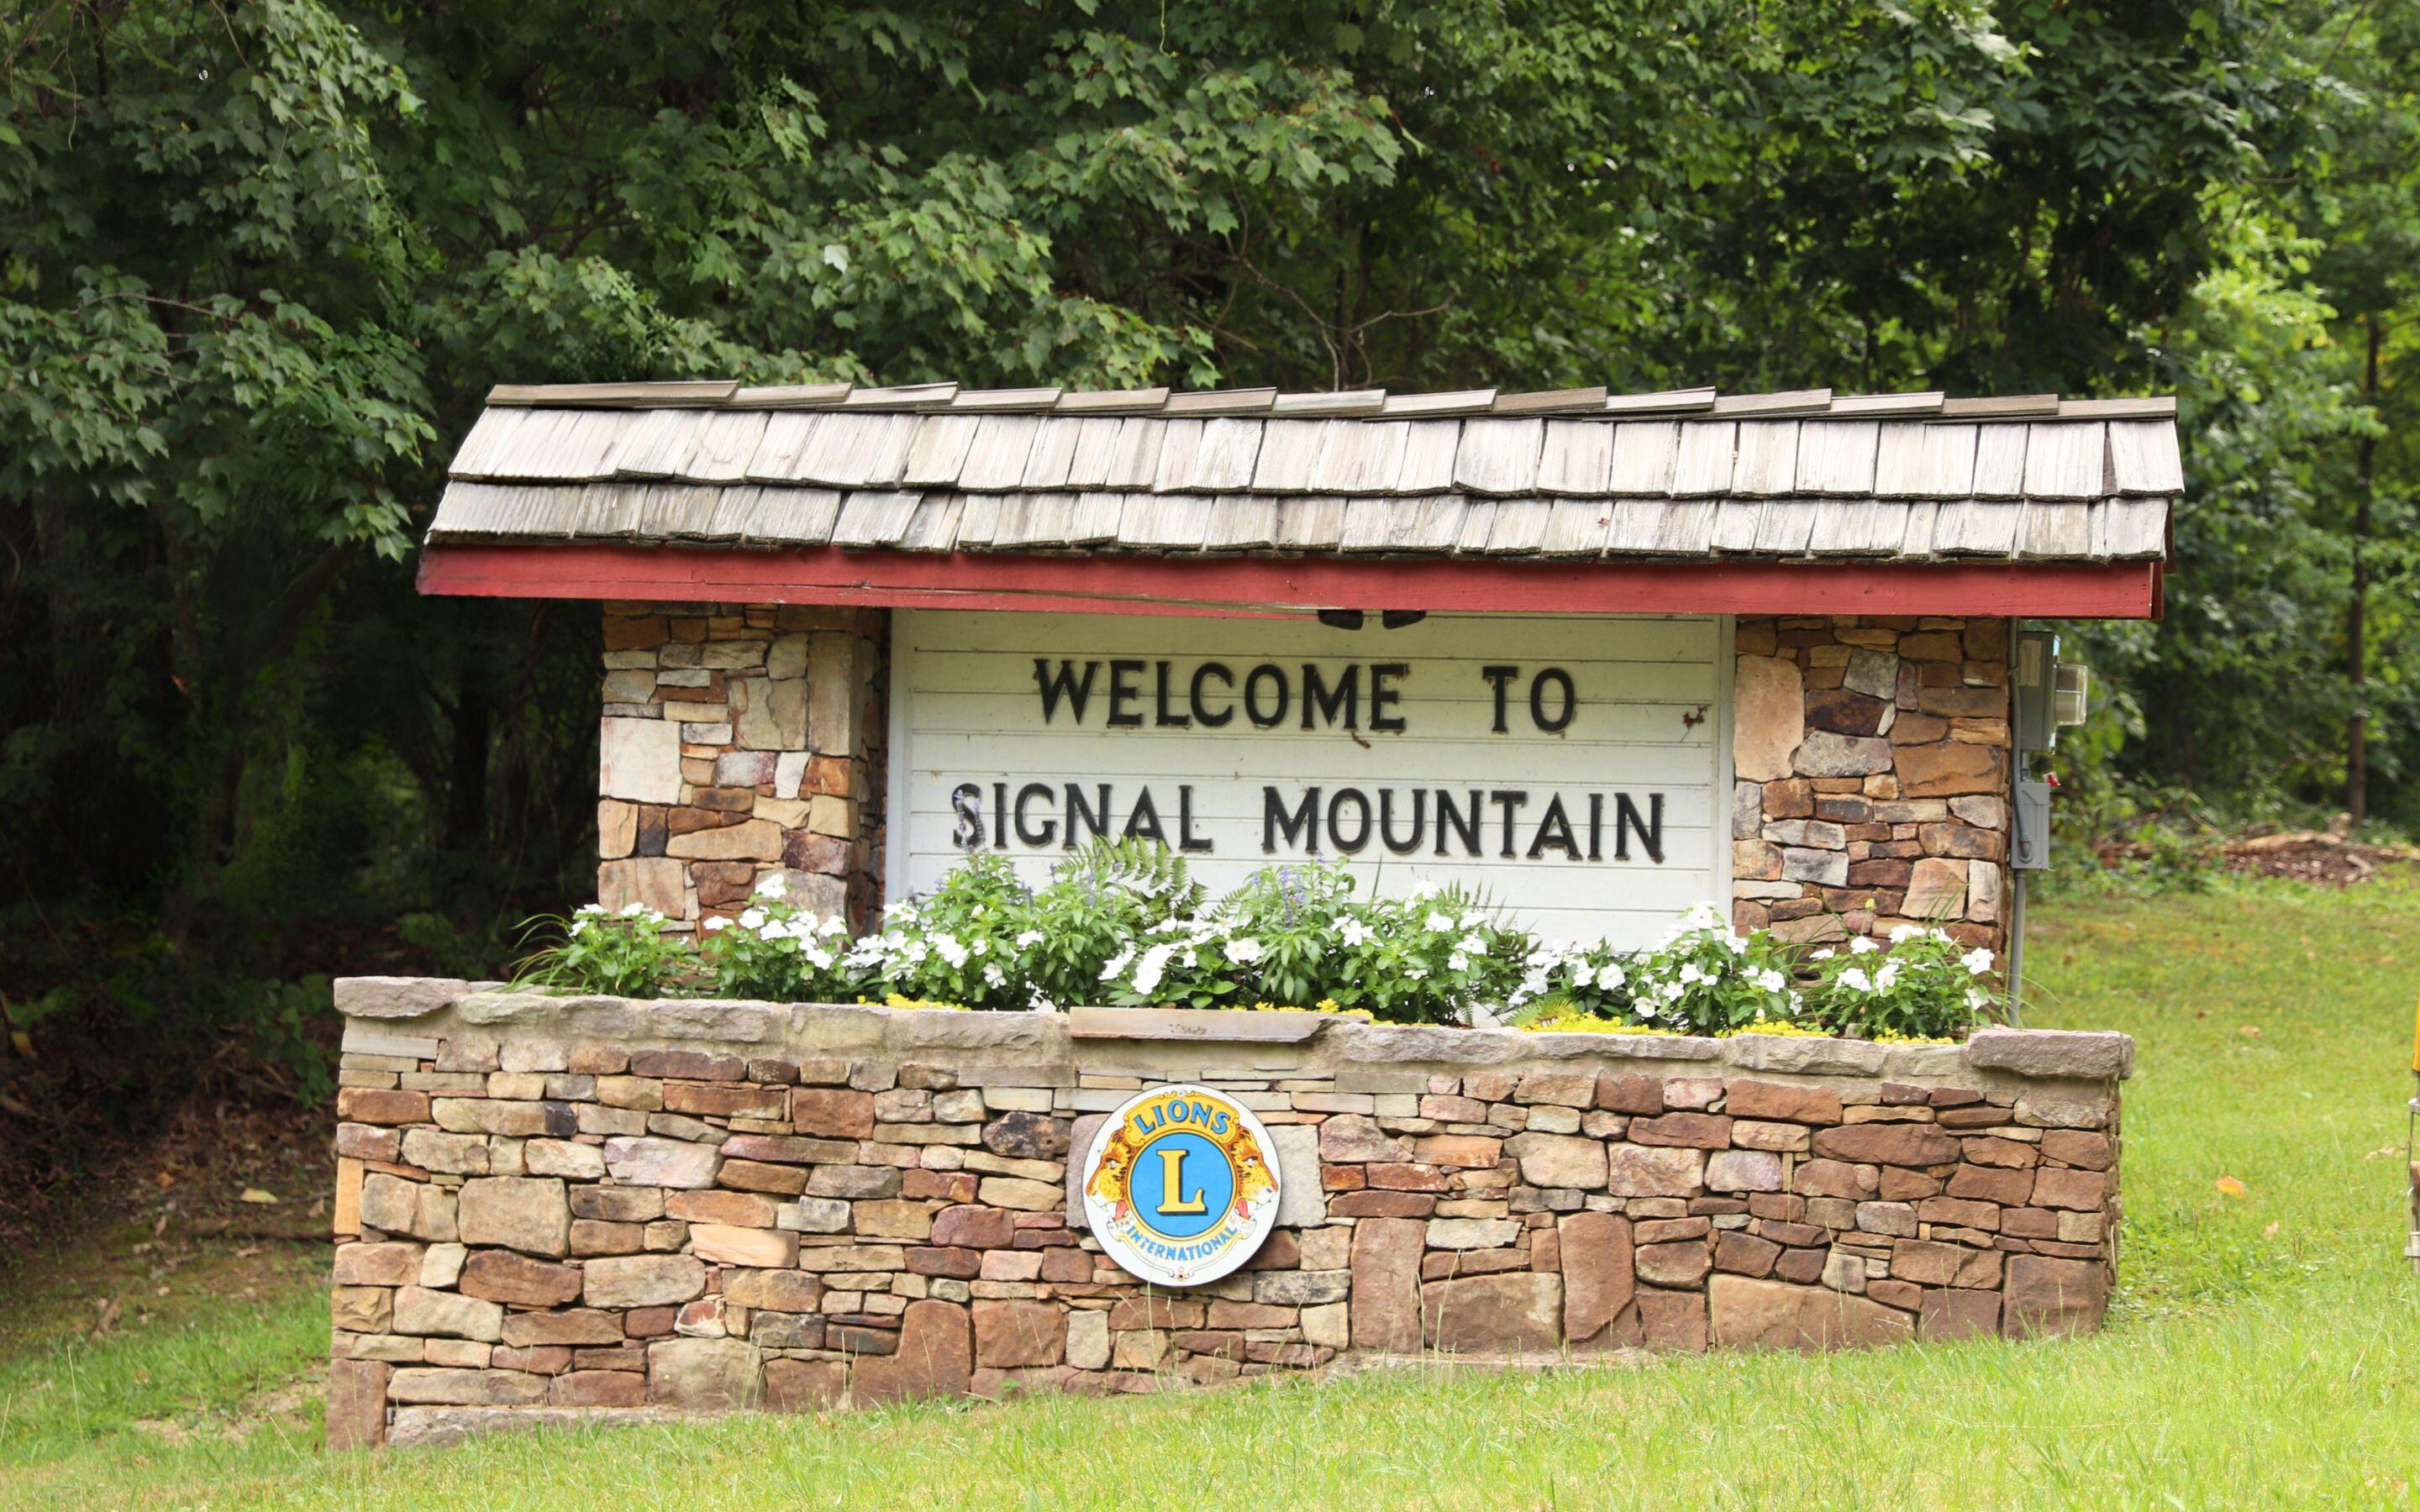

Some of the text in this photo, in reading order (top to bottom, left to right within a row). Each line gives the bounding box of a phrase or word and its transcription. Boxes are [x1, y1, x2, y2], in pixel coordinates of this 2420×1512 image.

[1034, 659, 1576, 735] WELCOME TO
[951, 781, 1665, 863] SIGNAL MOUNTAIN
[1134, 1100, 1230, 1134] LIONS
[1156, 1149, 1208, 1215] L
[1126, 1226, 1238, 1261] INTERNATIONAL
